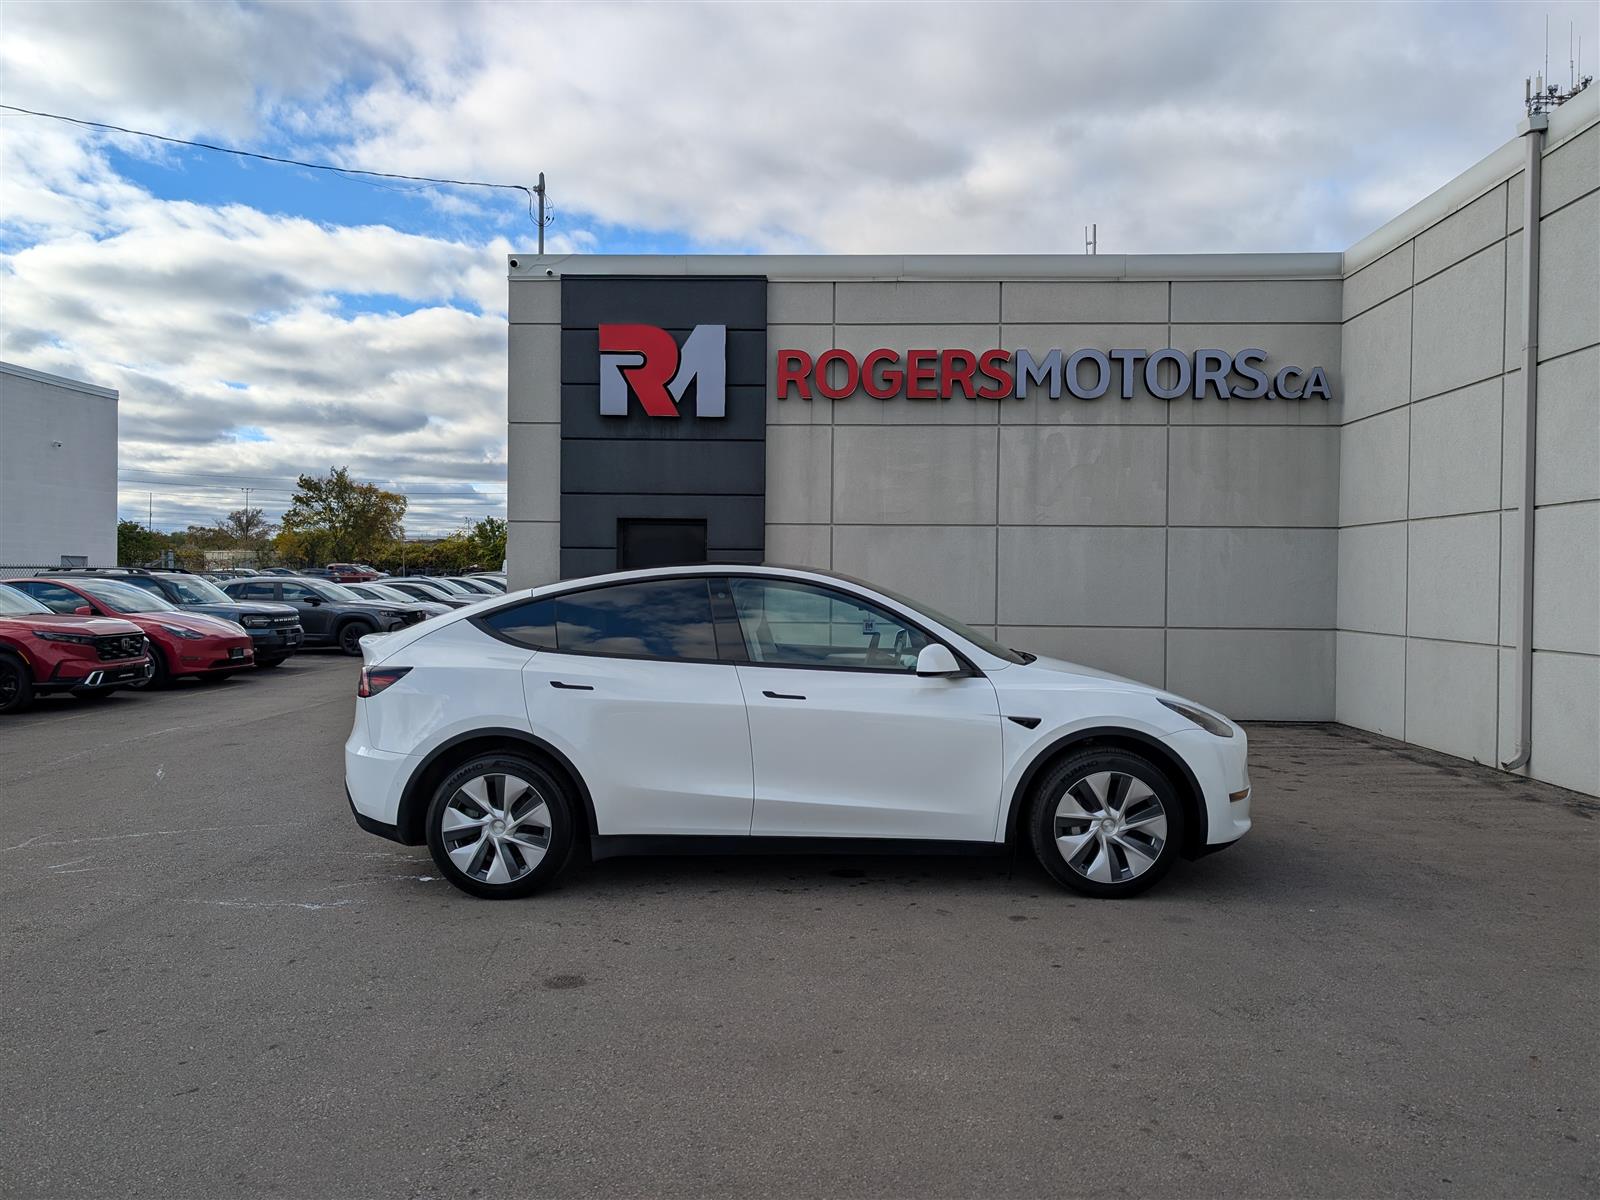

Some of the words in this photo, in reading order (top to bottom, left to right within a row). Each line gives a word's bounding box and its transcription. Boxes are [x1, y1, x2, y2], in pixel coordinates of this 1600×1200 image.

[599, 323, 726, 417] RM
[777, 348, 1331, 400] ROGERSMOTORS.CA
[448, 763, 484, 786] KUMHO
